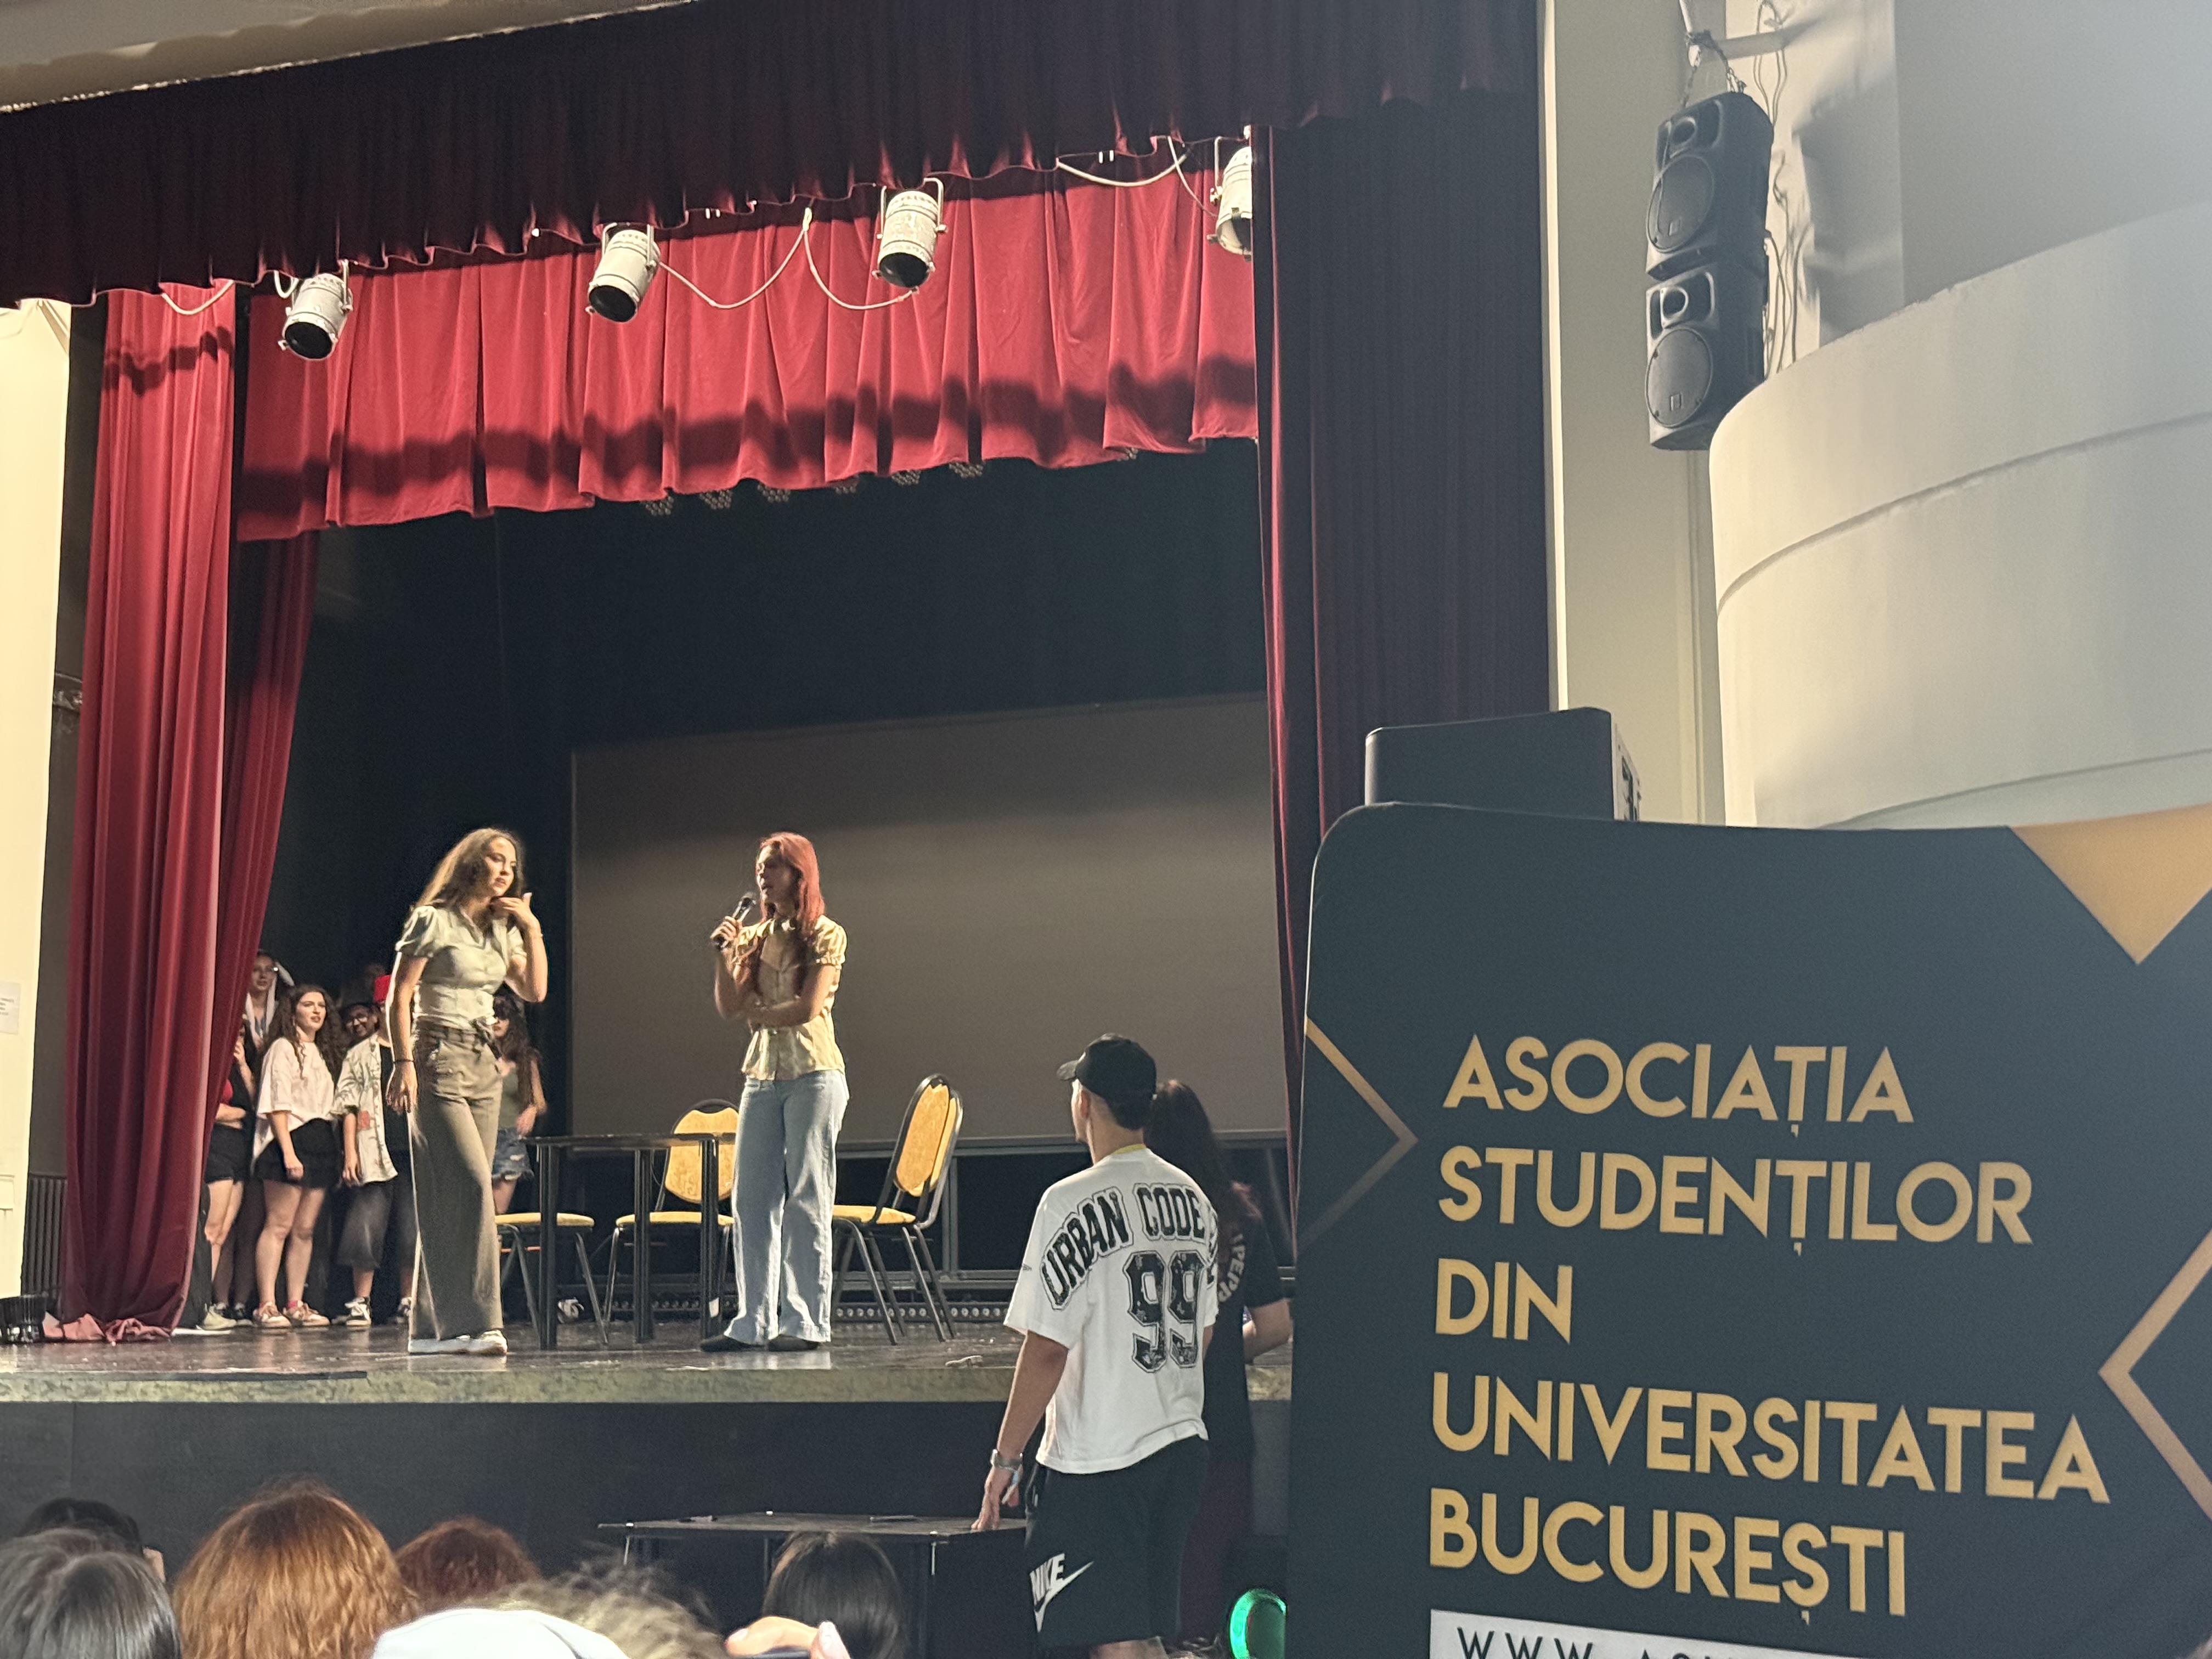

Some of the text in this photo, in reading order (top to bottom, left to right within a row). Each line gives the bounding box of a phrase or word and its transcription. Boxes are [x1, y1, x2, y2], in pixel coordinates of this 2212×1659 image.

[1442, 1034, 1914, 1138] ASOCIAȚIA
[1040, 1187, 1133, 1311] URBAN
[1133, 1183, 1209, 1241] CODE
[1438, 1146, 2033, 1256] STUDENȚILOR
[1122, 1250, 1206, 1373] 99
[1218, 1245, 1246, 1302] PEPP
[1435, 1257, 1573, 1344] DIN
[1431, 1372, 2111, 1504] UNIVERSITATEA
[1029, 1553, 1065, 1606] NIKE
[1429, 1488, 1906, 1626] BUCUREȘTI
